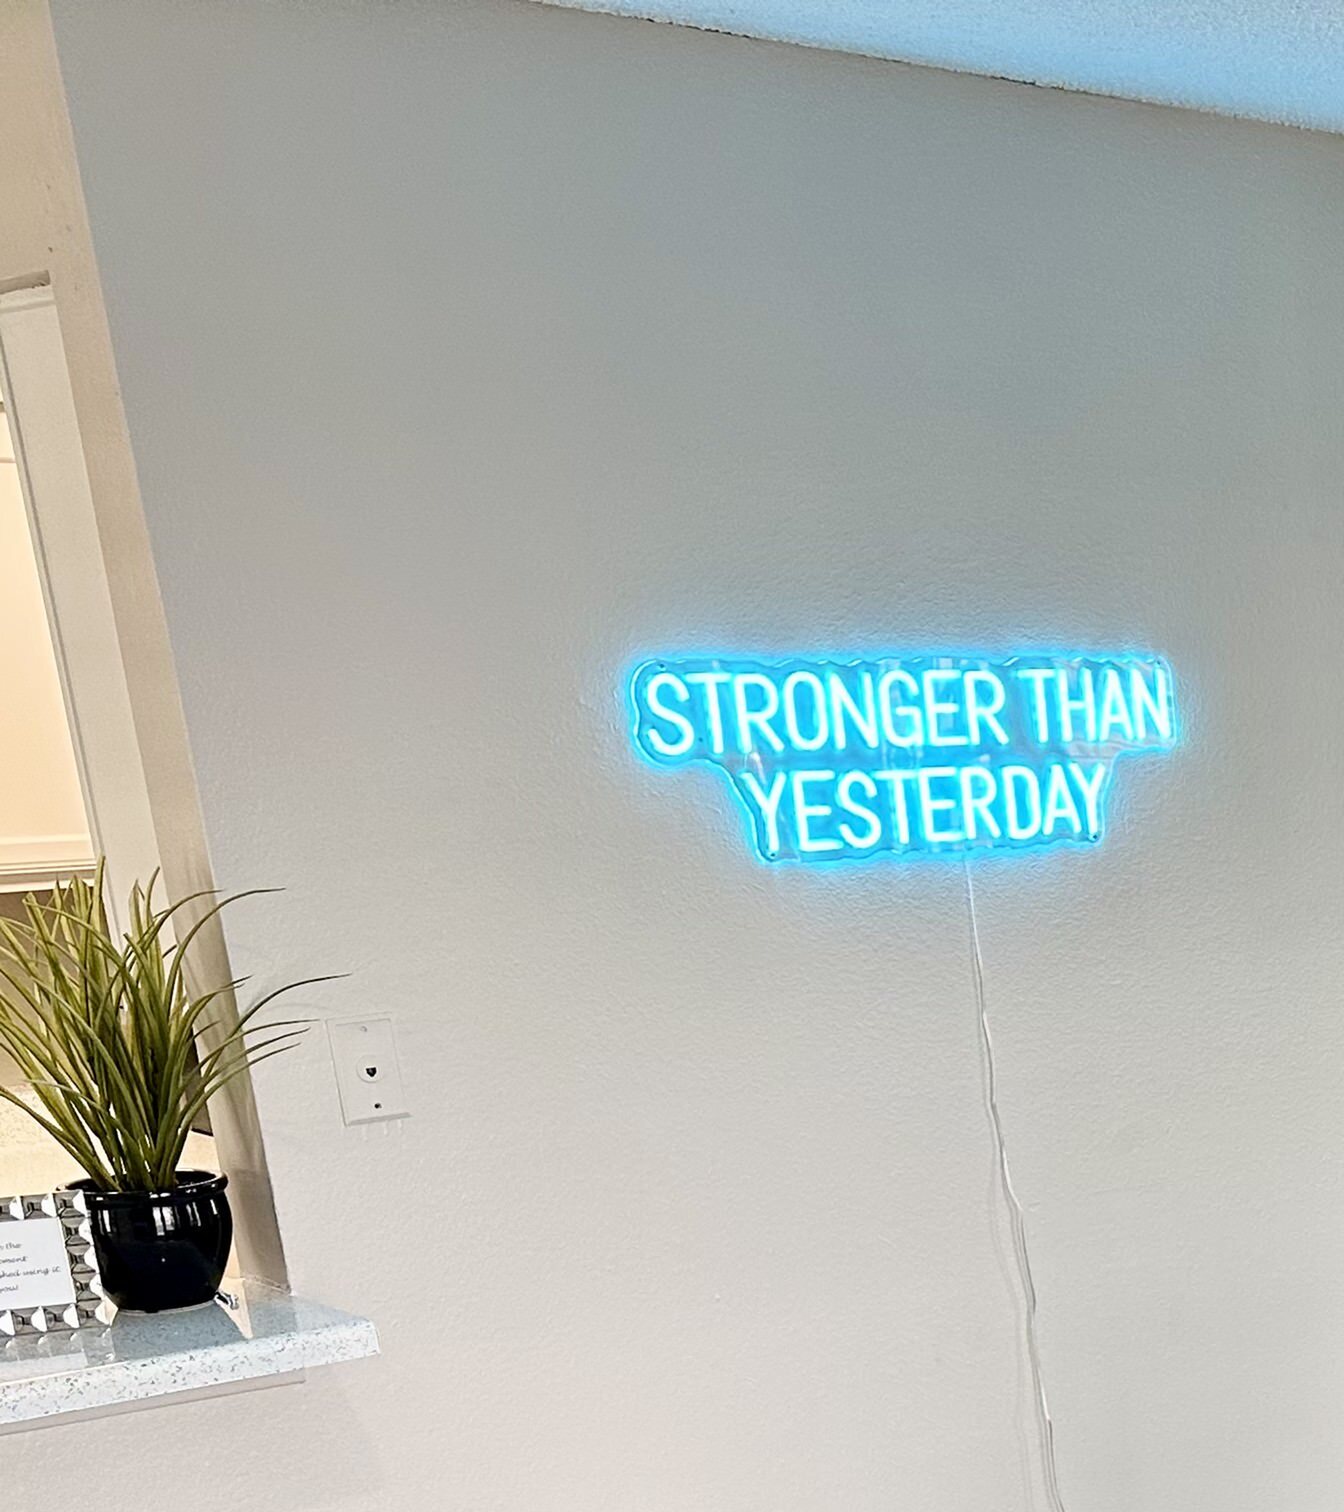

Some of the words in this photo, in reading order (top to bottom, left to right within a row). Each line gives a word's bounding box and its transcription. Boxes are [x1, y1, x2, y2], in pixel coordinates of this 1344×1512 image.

[646, 670, 1010, 756] STRONGER
[1016, 667, 1173, 744] THAN
[740, 762, 1106, 854] YESTERDAY
